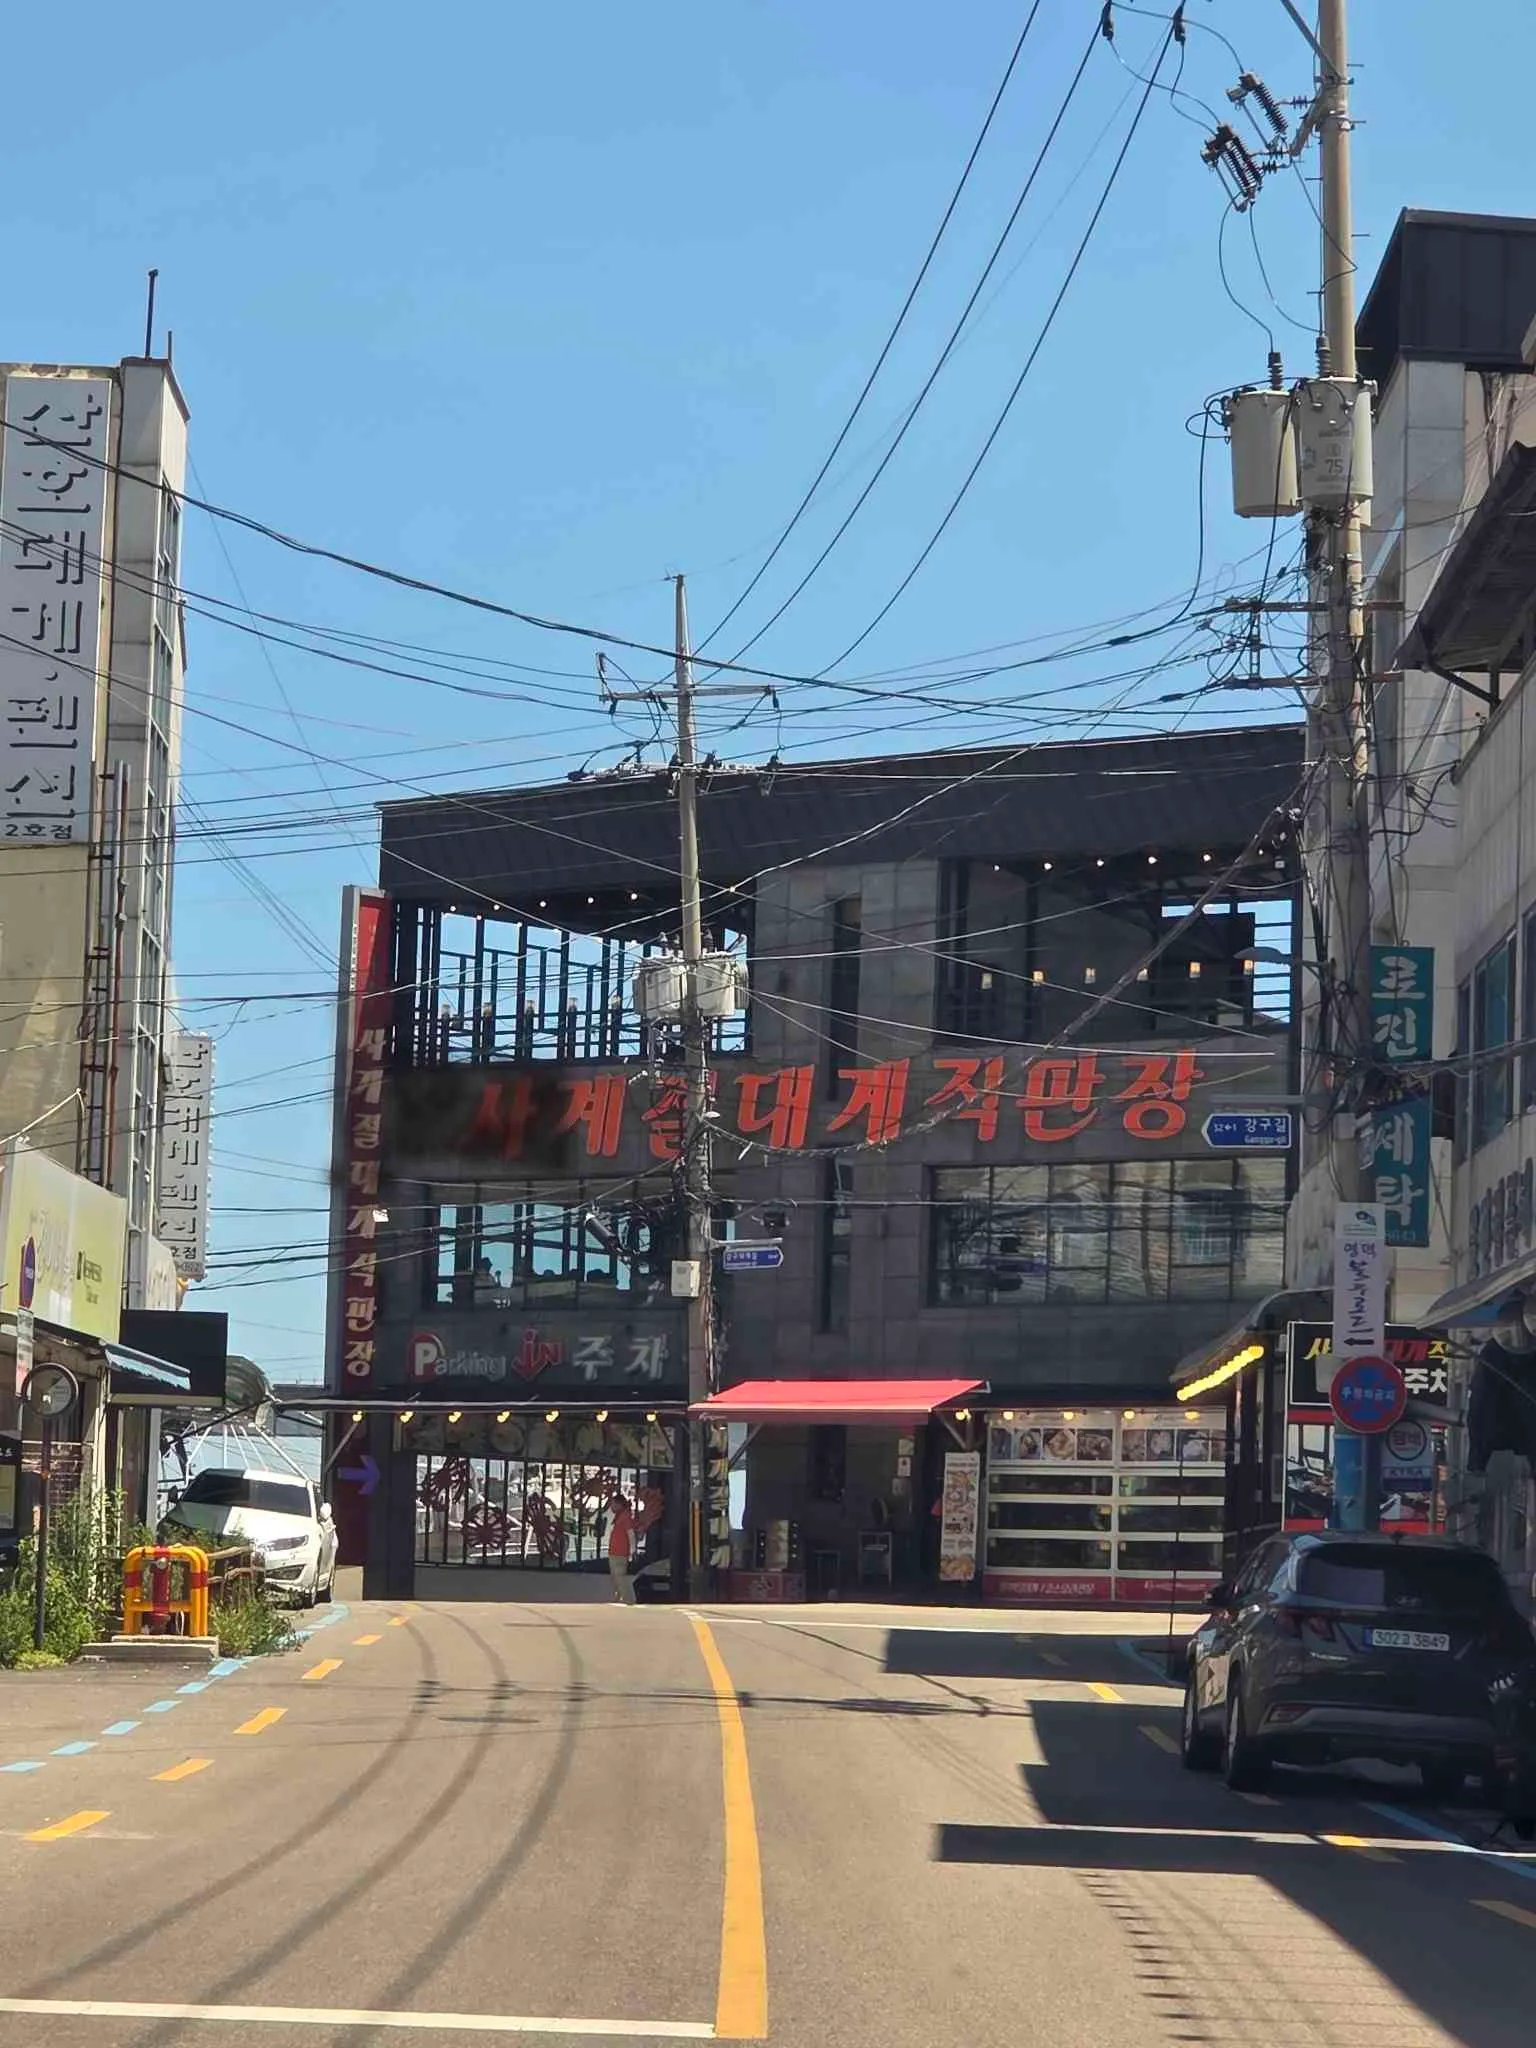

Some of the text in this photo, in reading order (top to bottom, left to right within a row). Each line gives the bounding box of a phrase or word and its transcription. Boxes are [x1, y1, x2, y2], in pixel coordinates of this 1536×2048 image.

[1324, 458, 1344, 474] 75
[6, 824, 73, 840] 2호점
[1244, 1118, 1286, 1133] 강구길
[414, 1341, 507, 1383] Parking
[572, 1334, 670, 1381] 주차
